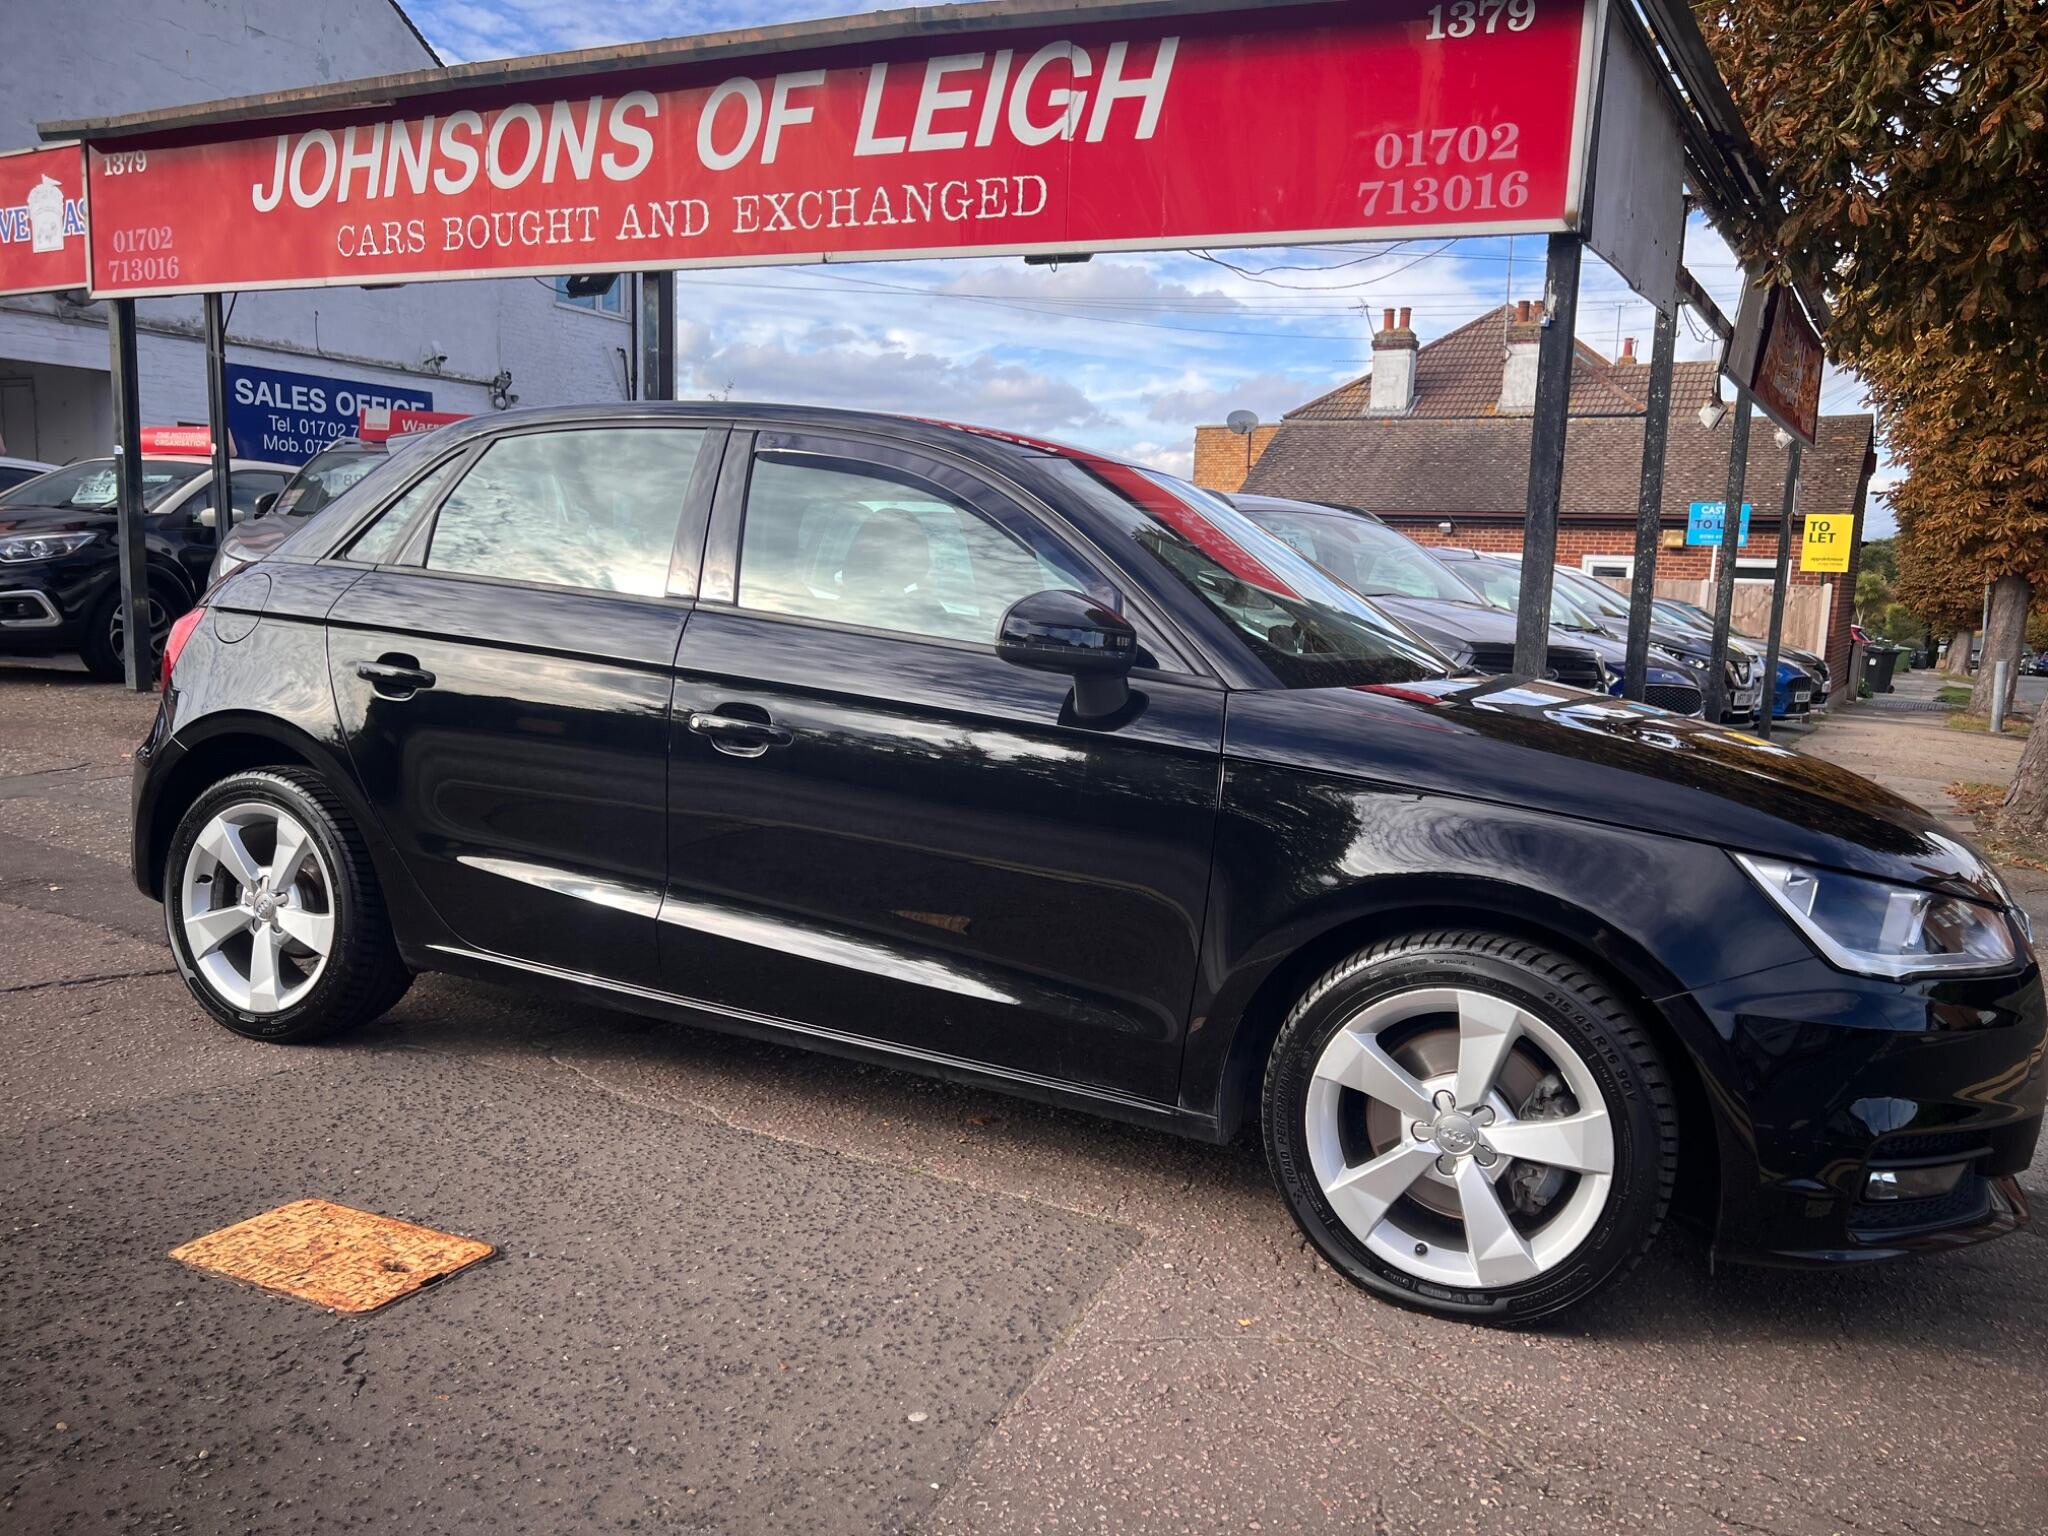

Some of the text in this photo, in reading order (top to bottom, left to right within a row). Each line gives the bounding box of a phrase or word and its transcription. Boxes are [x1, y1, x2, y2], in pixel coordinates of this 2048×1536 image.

[1425, 0, 1536, 40] 1379
[252, 36, 1181, 212] JOHNSONS OF LEIGH
[1374, 122, 1519, 170] 01702
[104, 150, 148, 176] 1379
[1358, 170, 1529, 217] 713016
[337, 173, 1048, 257] CARS BOUGHT AND EXCHANGED
[113, 226, 174, 253] 01702
[108, 256, 180, 283] 713016
[234, 378, 327, 414] SALES
[268, 414, 295, 434] Tel.
[263, 433, 303, 453] Mob.
[1695, 519, 1713, 529] TO
[1809, 533, 1837, 544] LET
[1810, 521, 1831, 532] TO
[1543, 991, 1595, 1033] 215/45
[1592, 1035, 1621, 1066] R16
[1275, 1052, 1298, 1185] ROAD PERFORMANCE
